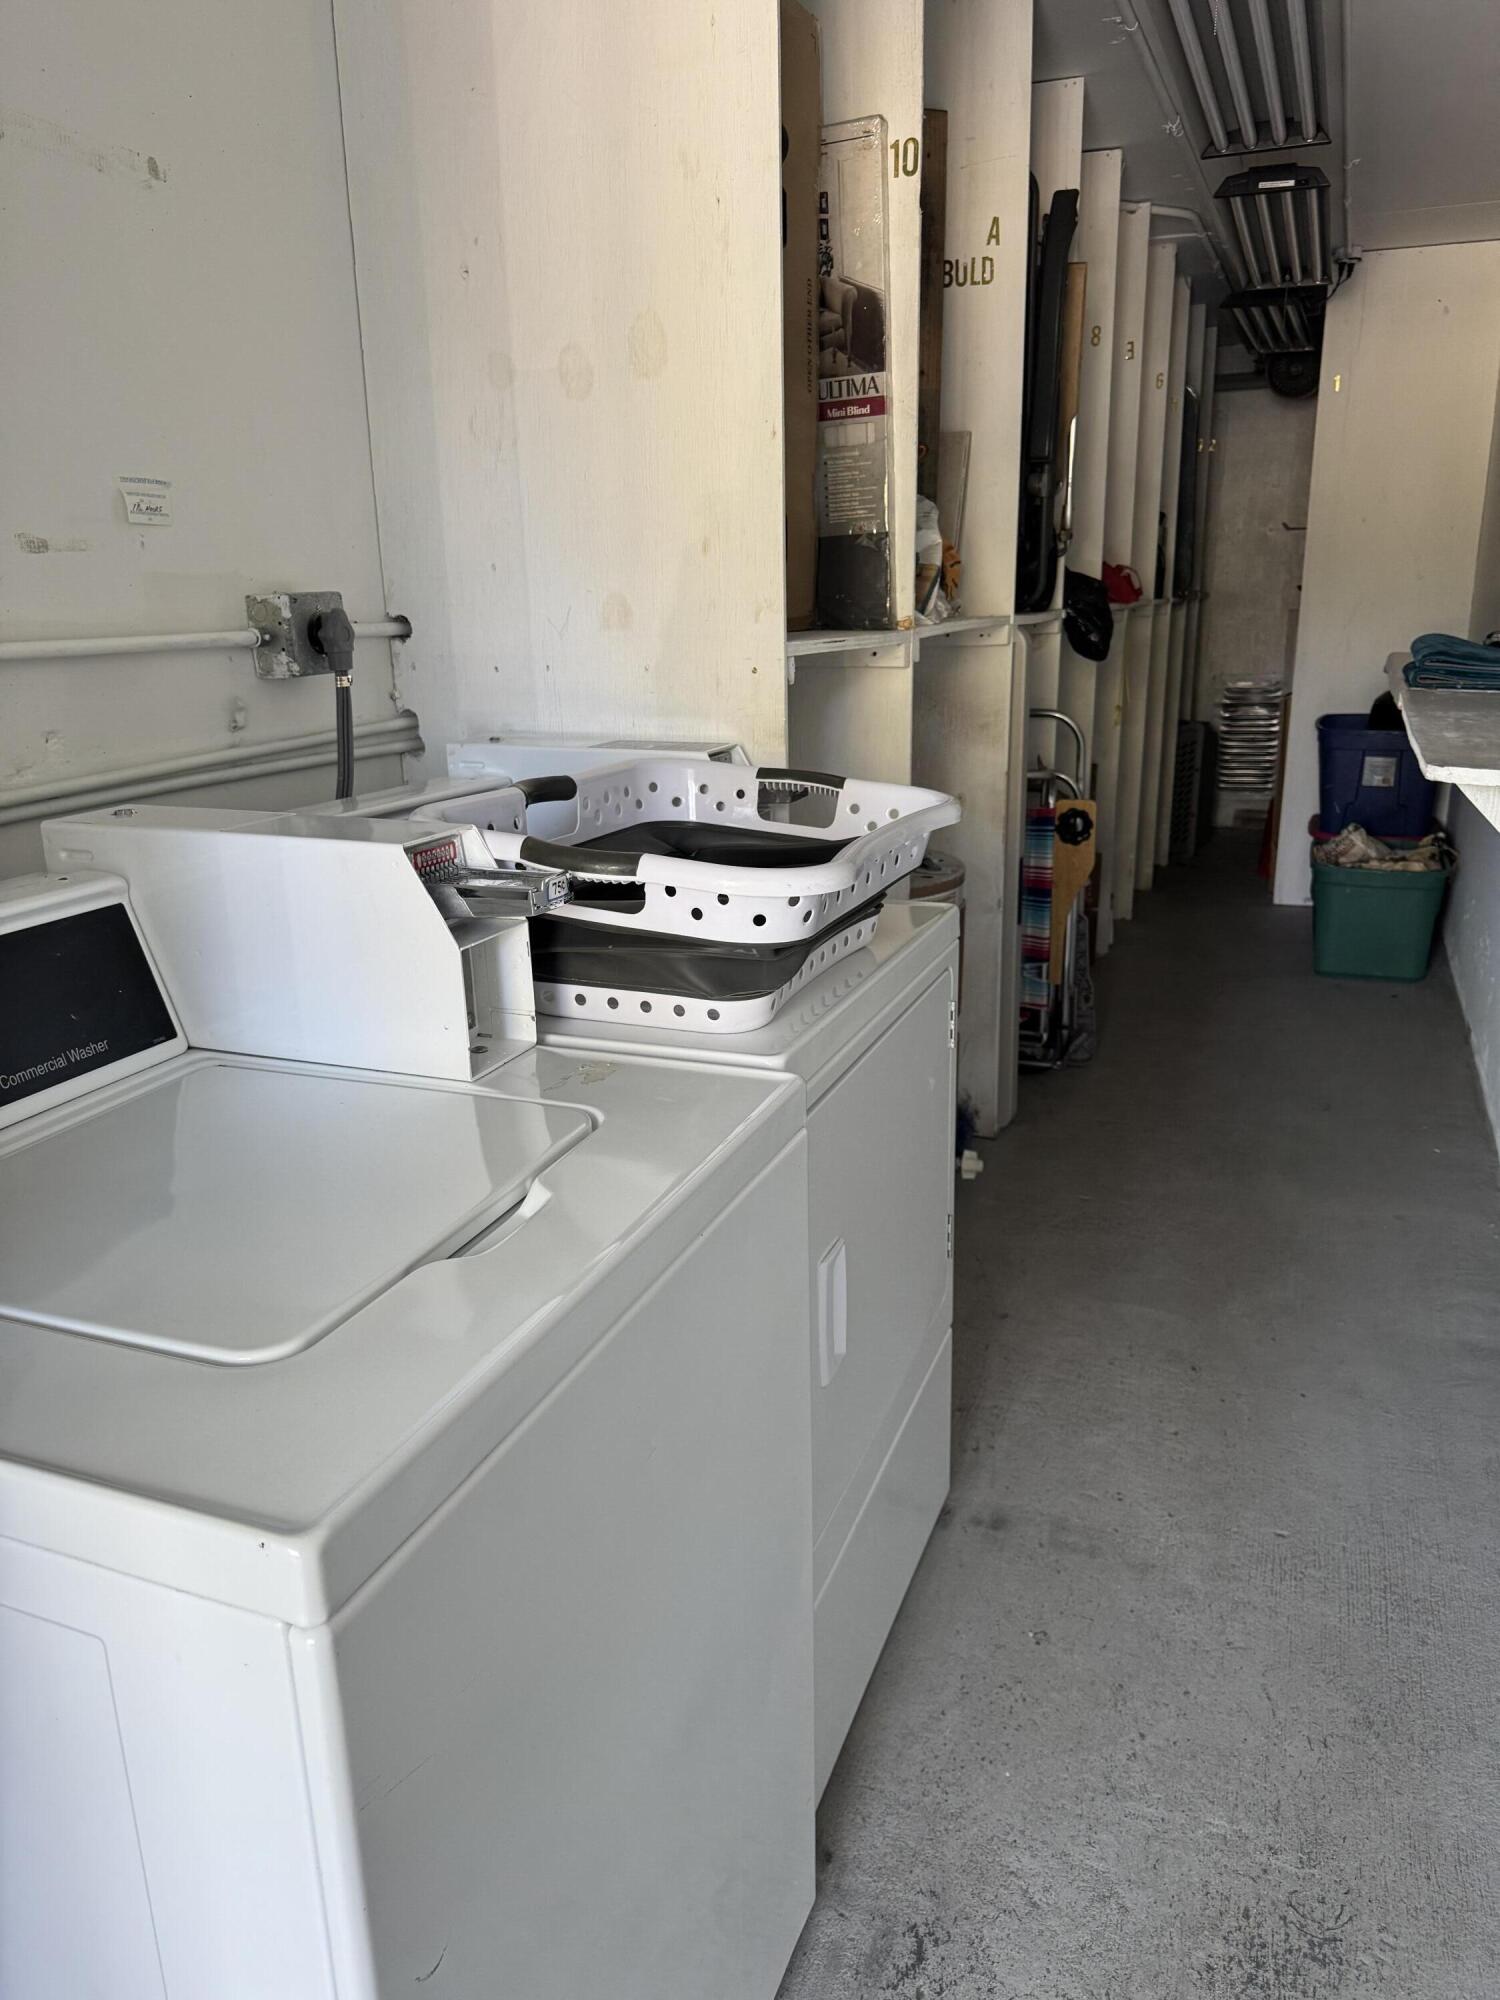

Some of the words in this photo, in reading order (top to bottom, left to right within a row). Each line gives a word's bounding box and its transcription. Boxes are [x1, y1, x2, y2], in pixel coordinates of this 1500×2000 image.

[889, 136, 919, 178] 10
[986, 215, 1001, 246] A
[943, 255, 995, 289] BULD
[1090, 325, 1101, 347] 8
[819, 375, 880, 400] ULTIMA
[1155, 372, 1165, 390] 6
[1333, 374, 1342, 393] 1
[827, 407, 846, 418] Mini
[846, 404, 871, 416] Blind
[0, 1053, 68, 1089] Commercial
[66, 1039, 109, 1063] Washer
